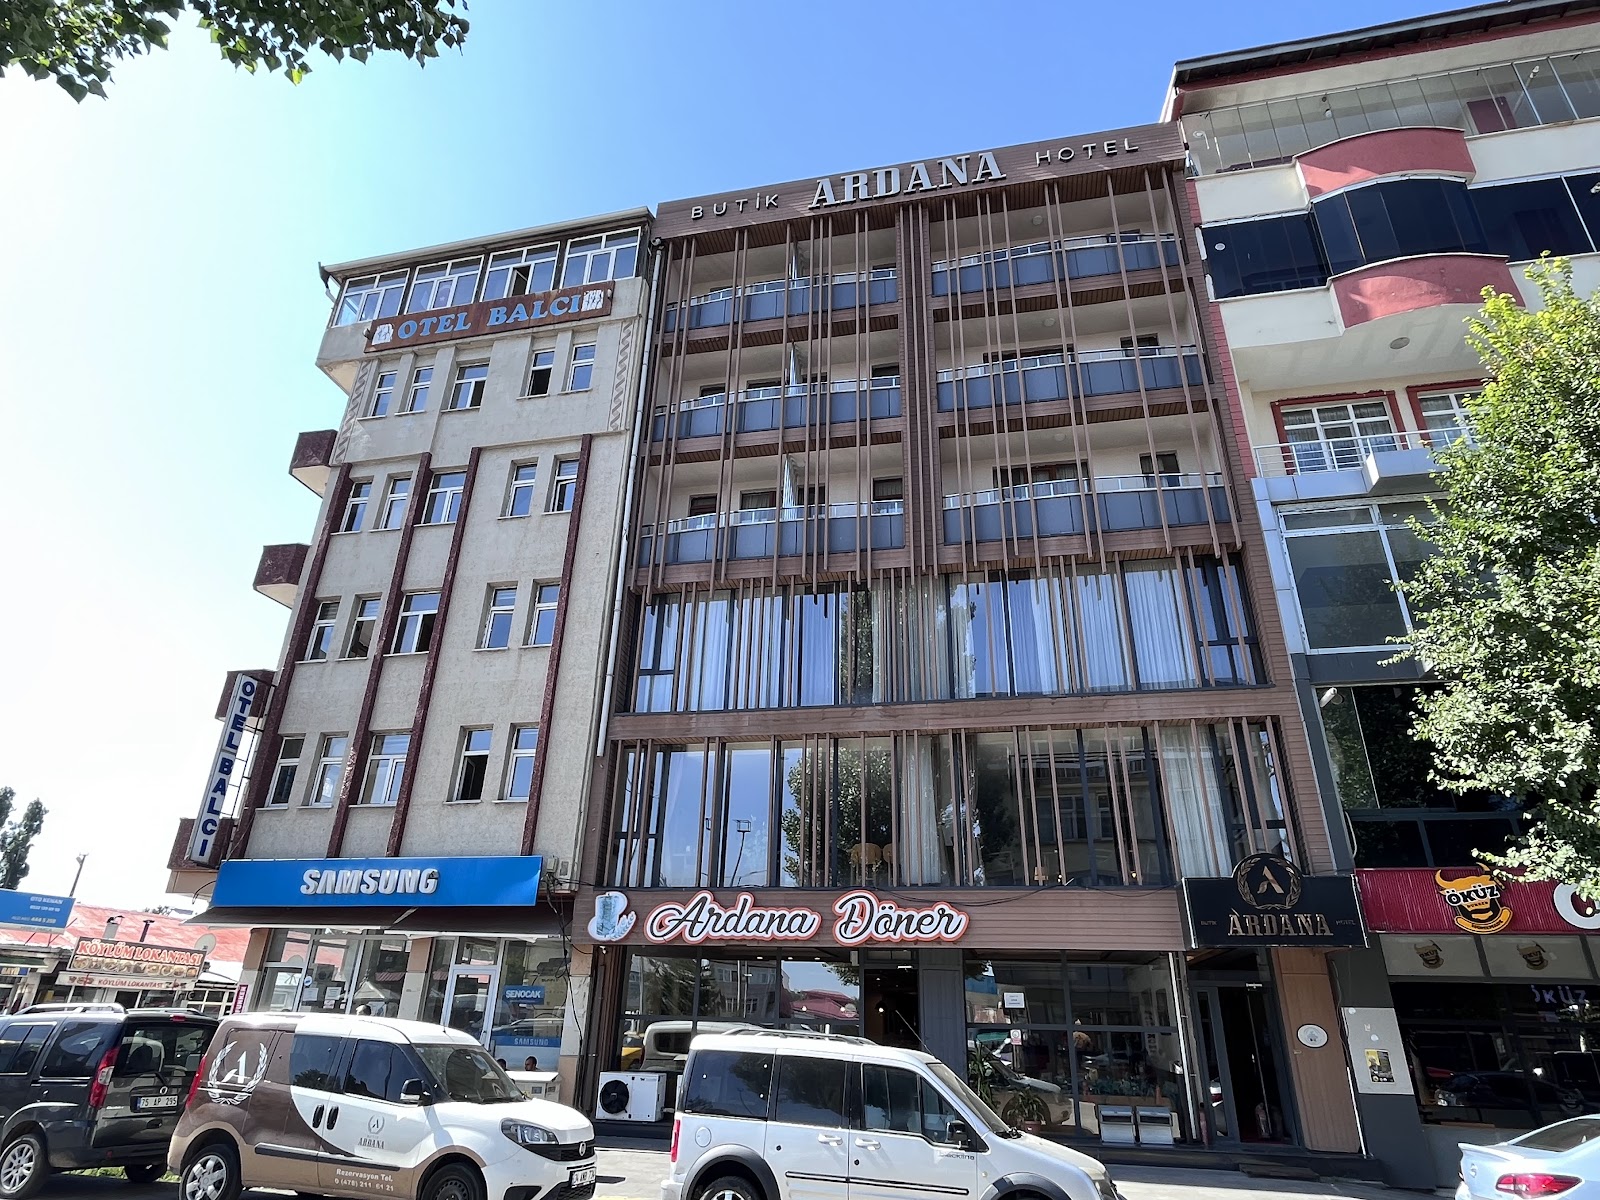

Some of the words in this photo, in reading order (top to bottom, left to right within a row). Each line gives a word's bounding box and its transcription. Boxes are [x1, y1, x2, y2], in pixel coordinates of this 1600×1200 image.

[691, 192, 779, 220] BUTİK
[808, 152, 1007, 209] ARDANA
[1034, 137, 1139, 167] HOTEL
[397, 312, 471, 339] OTEL
[488, 295, 580, 326] BALCI
[225, 681, 255, 750] OTEL
[199, 757, 234, 857] BALCI
[300, 868, 440, 895] SAMSUNG
[1446, 884, 1500, 906] ÖKÜZ
[647, 890, 818, 944] Ardana
[834, 890, 967, 943] Döner
[1228, 910, 1333, 936] ARDANA
[77, 939, 135, 959] KÖYLÜM
[134, 947, 203, 966] LOKANTASI
[98, 977, 127, 987] KÖYLÜM
[127, 980, 164, 989] LOKANTASI
[506, 989, 541, 999] ŞENOCAK
[514, 1037, 549, 1046] SAMSUNG
[142, 1098, 149, 1106] 75
[358, 1138, 385, 1149] ARDANA
[336, 1168, 379, 1180] Rezervasyon
[380, 1173, 393, 1182] Tel.
[385, 1184, 394, 1192] 21
